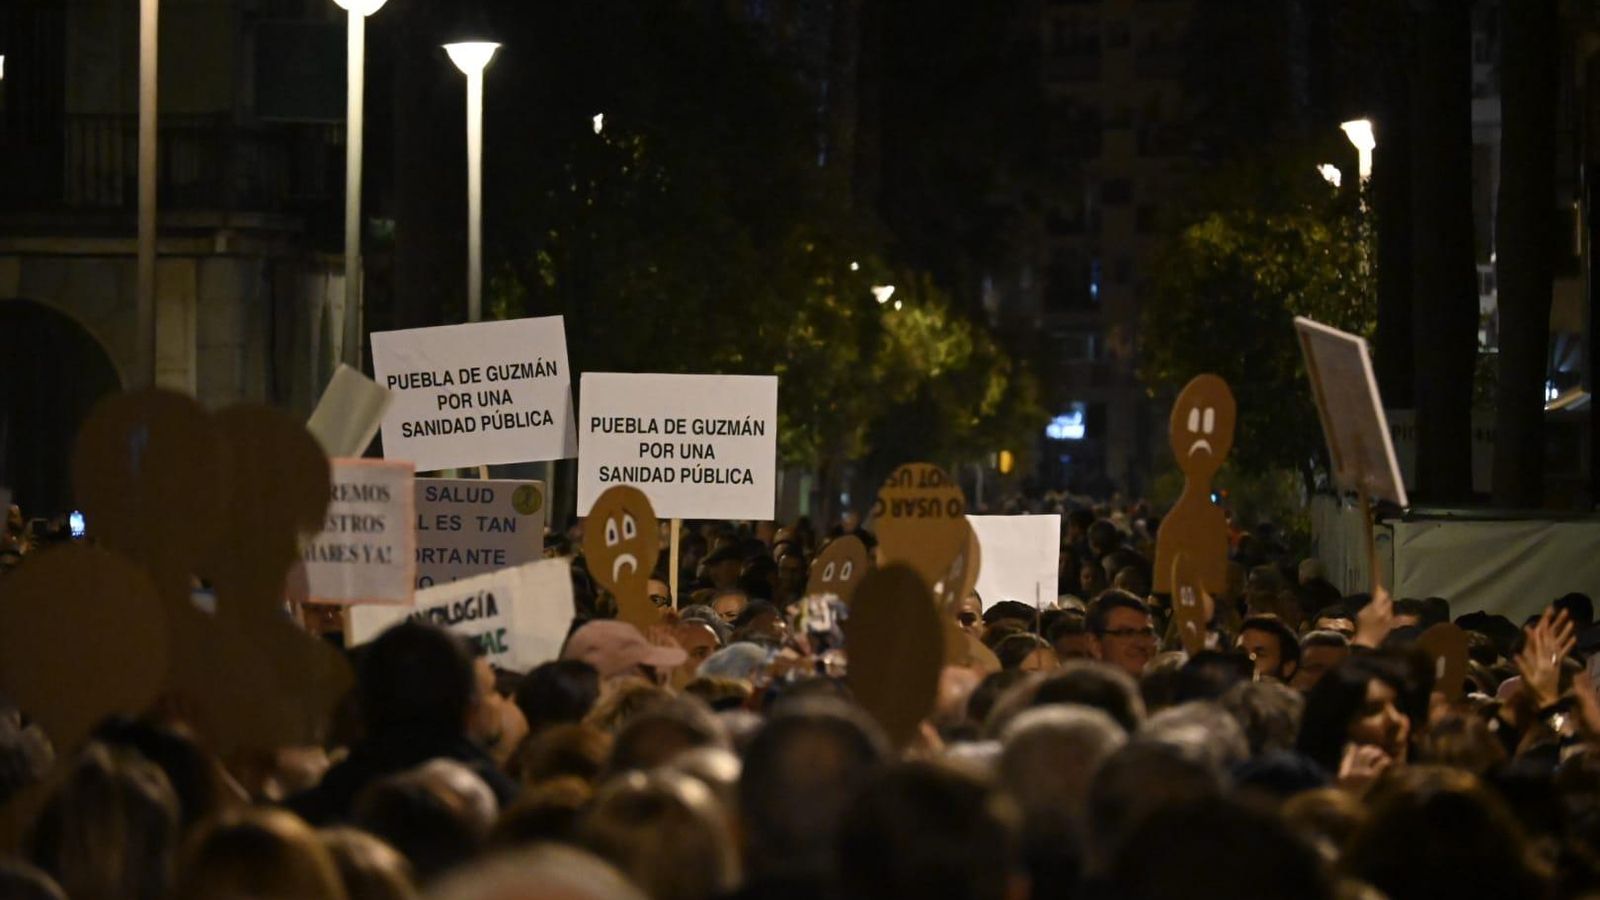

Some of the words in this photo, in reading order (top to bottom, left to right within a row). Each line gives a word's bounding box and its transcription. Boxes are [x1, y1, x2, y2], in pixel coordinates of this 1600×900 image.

[387, 370, 454, 390] PUEBLA
[459, 367, 482, 384] DE
[486, 357, 558, 382] GUZMÁN
[437, 393, 473, 410] POR
[477, 389, 513, 407] UNA
[402, 417, 476, 438] SANIDAD
[481, 409, 553, 431] PÚBLICA
[591, 417, 659, 434] PUEBLA
[664, 419, 687, 434] DE
[692, 416, 765, 436] GUZMÁN
[639, 443, 674, 458] POR
[680, 444, 715, 460] UNA
[599, 466, 675, 483] SANIDAD
[681, 464, 754, 485] PÚBLICA
[330, 483, 391, 502] REMOS
[425, 486, 495, 504] SALUD
[890, 497, 942, 518] USAR
[436, 514, 462, 531] ES
[477, 516, 517, 533] TAN
[416, 548, 506, 566] RTANTE
